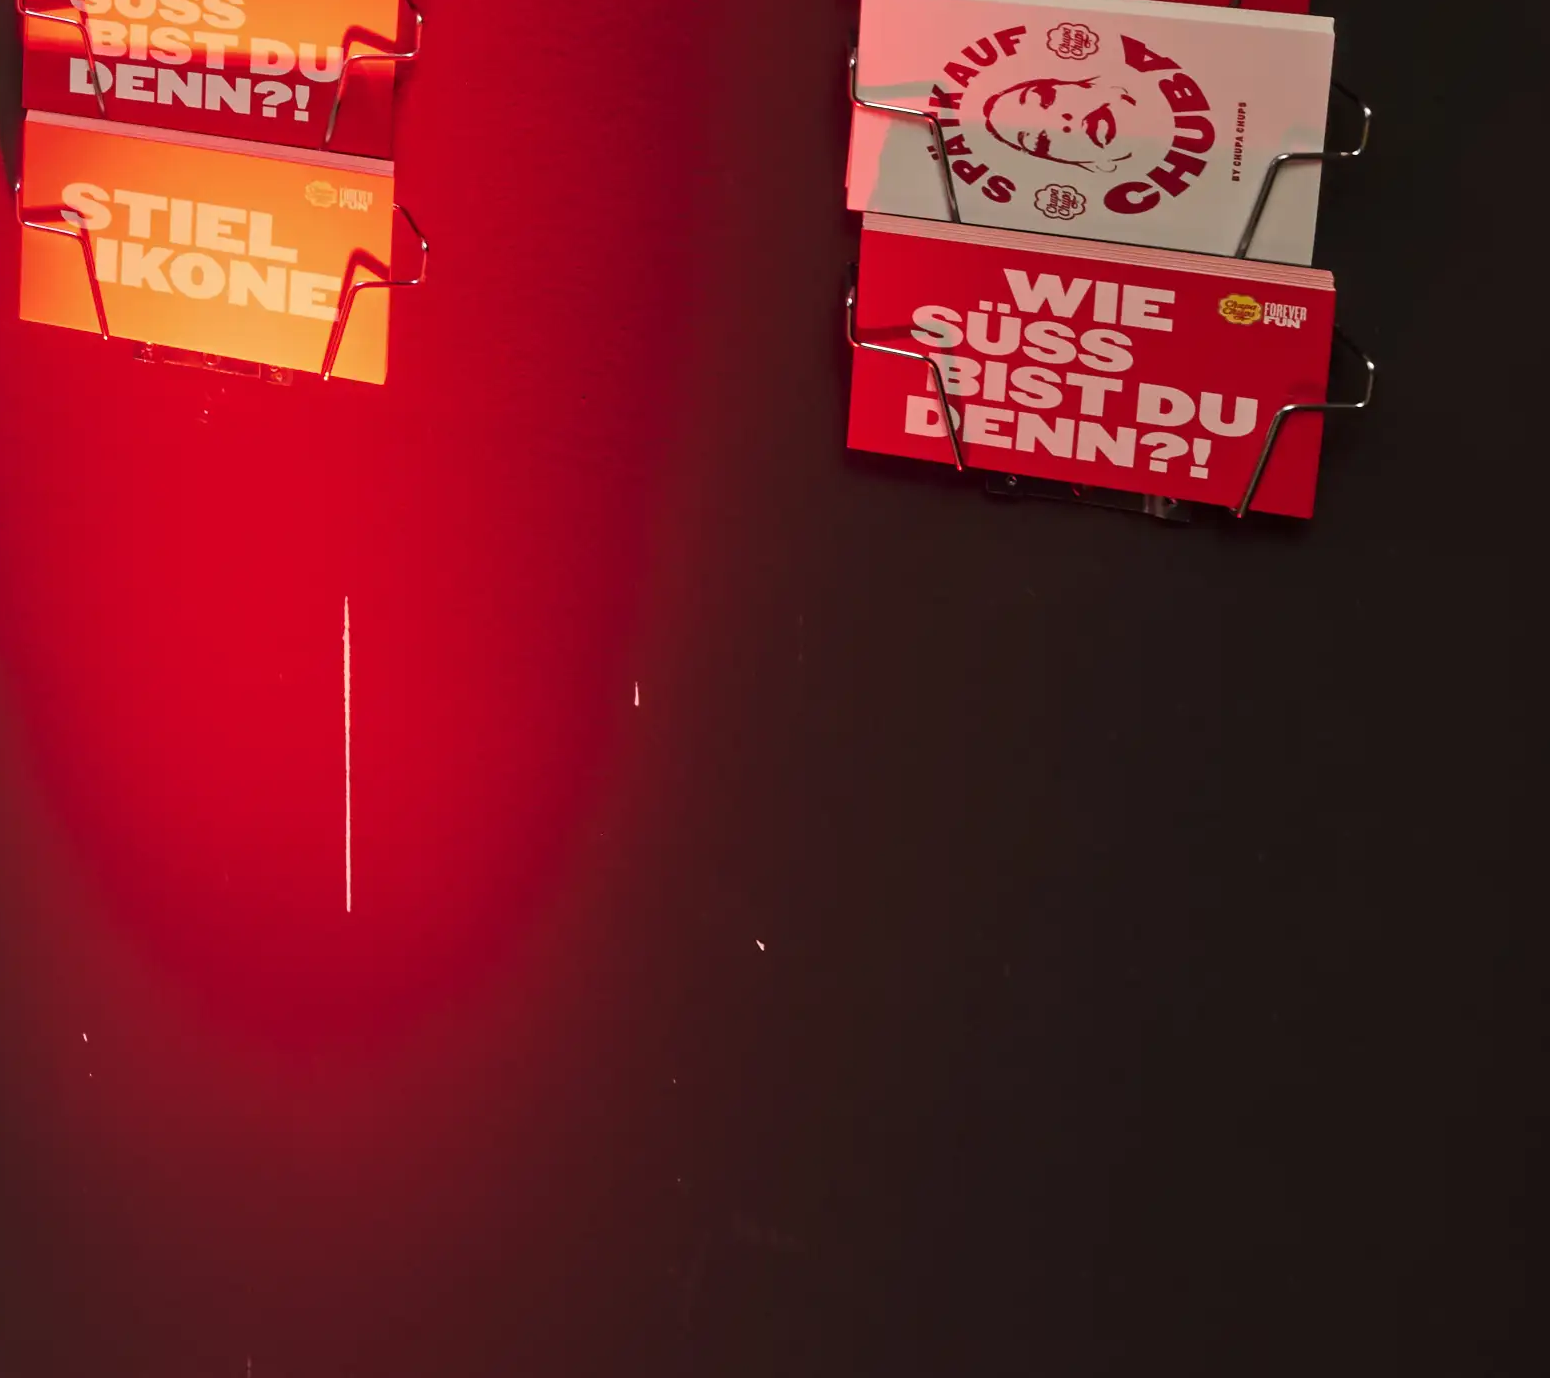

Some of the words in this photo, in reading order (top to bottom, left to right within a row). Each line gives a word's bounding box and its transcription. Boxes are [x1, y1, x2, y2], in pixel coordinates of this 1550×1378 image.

[90, 19, 246, 74] BIST
[249, 37, 344, 83] DU
[69, 58, 312, 122] DENN?!
